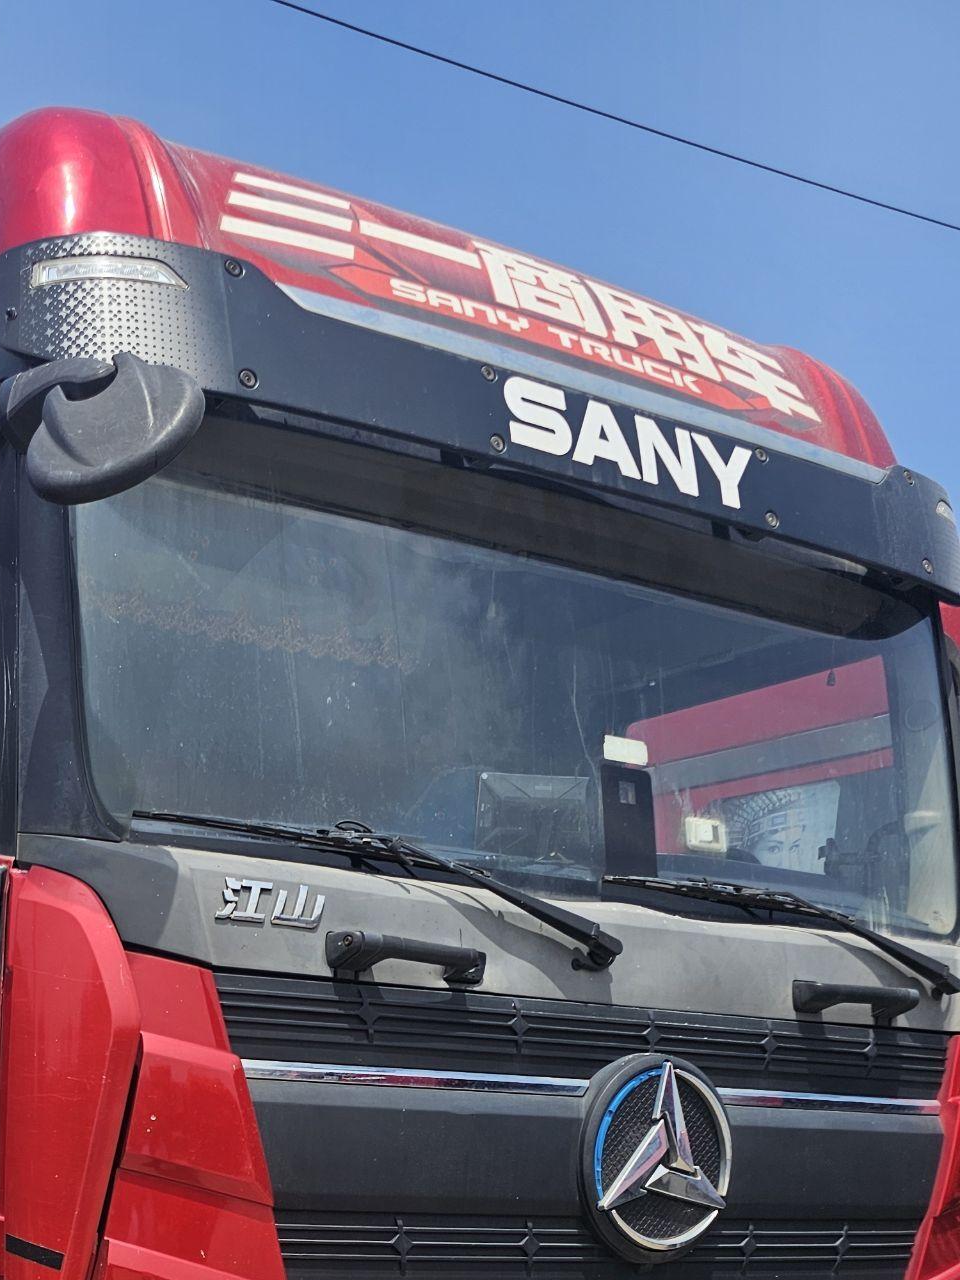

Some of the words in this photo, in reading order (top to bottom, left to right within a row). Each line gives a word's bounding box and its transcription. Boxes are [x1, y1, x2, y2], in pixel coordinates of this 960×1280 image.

[220, 172, 822, 423] 三一商用车
[389, 276, 532, 332] SANY
[546, 325, 704, 395] TRUCK
[503, 375, 753, 510] SANY
[214, 876, 326, 929] 江山
